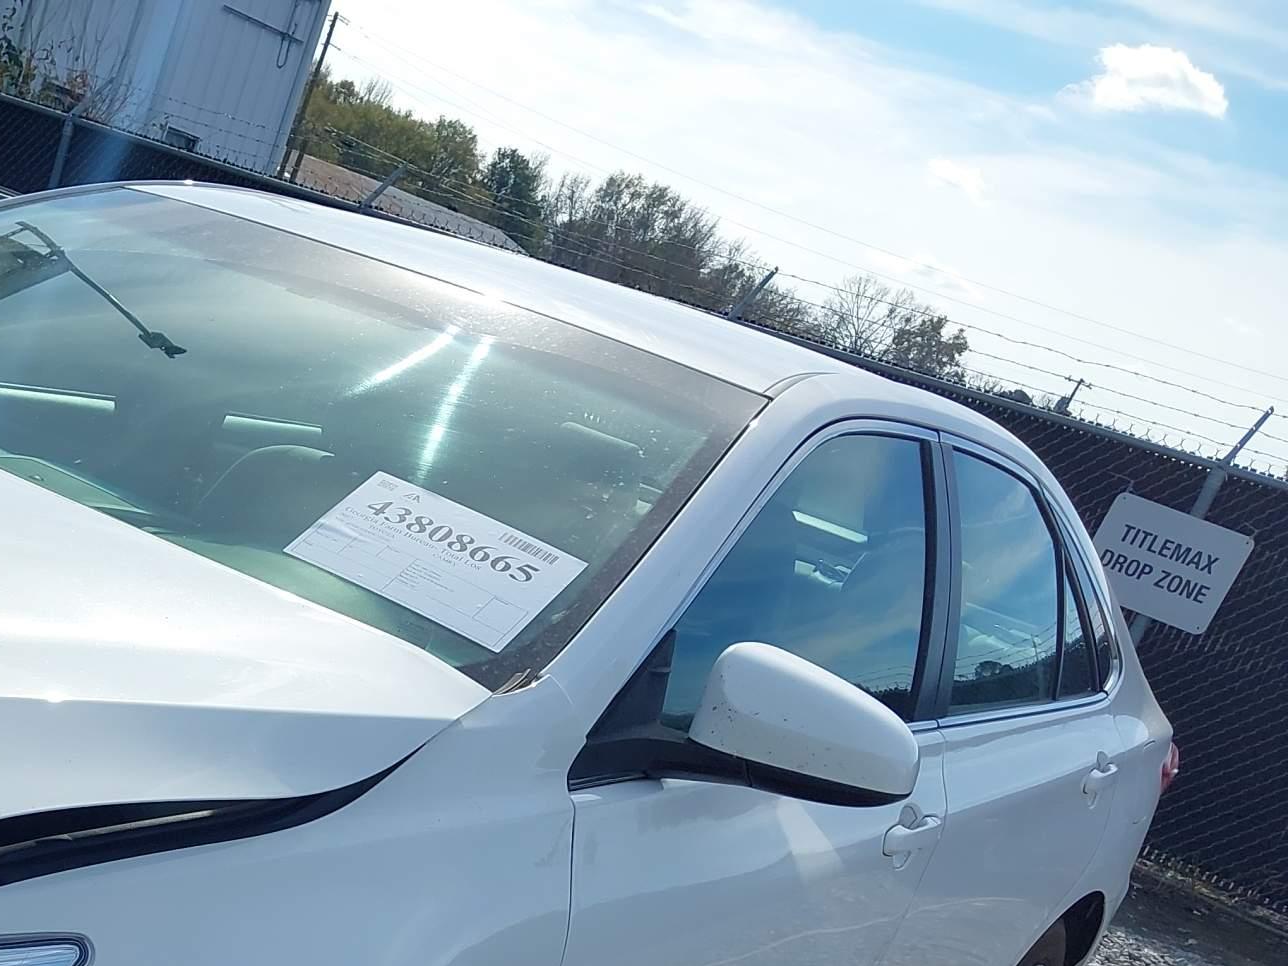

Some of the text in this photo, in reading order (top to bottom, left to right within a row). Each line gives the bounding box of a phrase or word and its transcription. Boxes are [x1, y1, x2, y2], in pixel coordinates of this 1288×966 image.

[345, 506, 380, 525] Georgia
[380, 521, 403, 535] Farm
[441, 549, 465, 562] Total
[368, 501, 541, 583] 43808665
[1120, 524, 1220, 575] TITLEMAX
[1100, 549, 1211, 604] DROP ZONE
